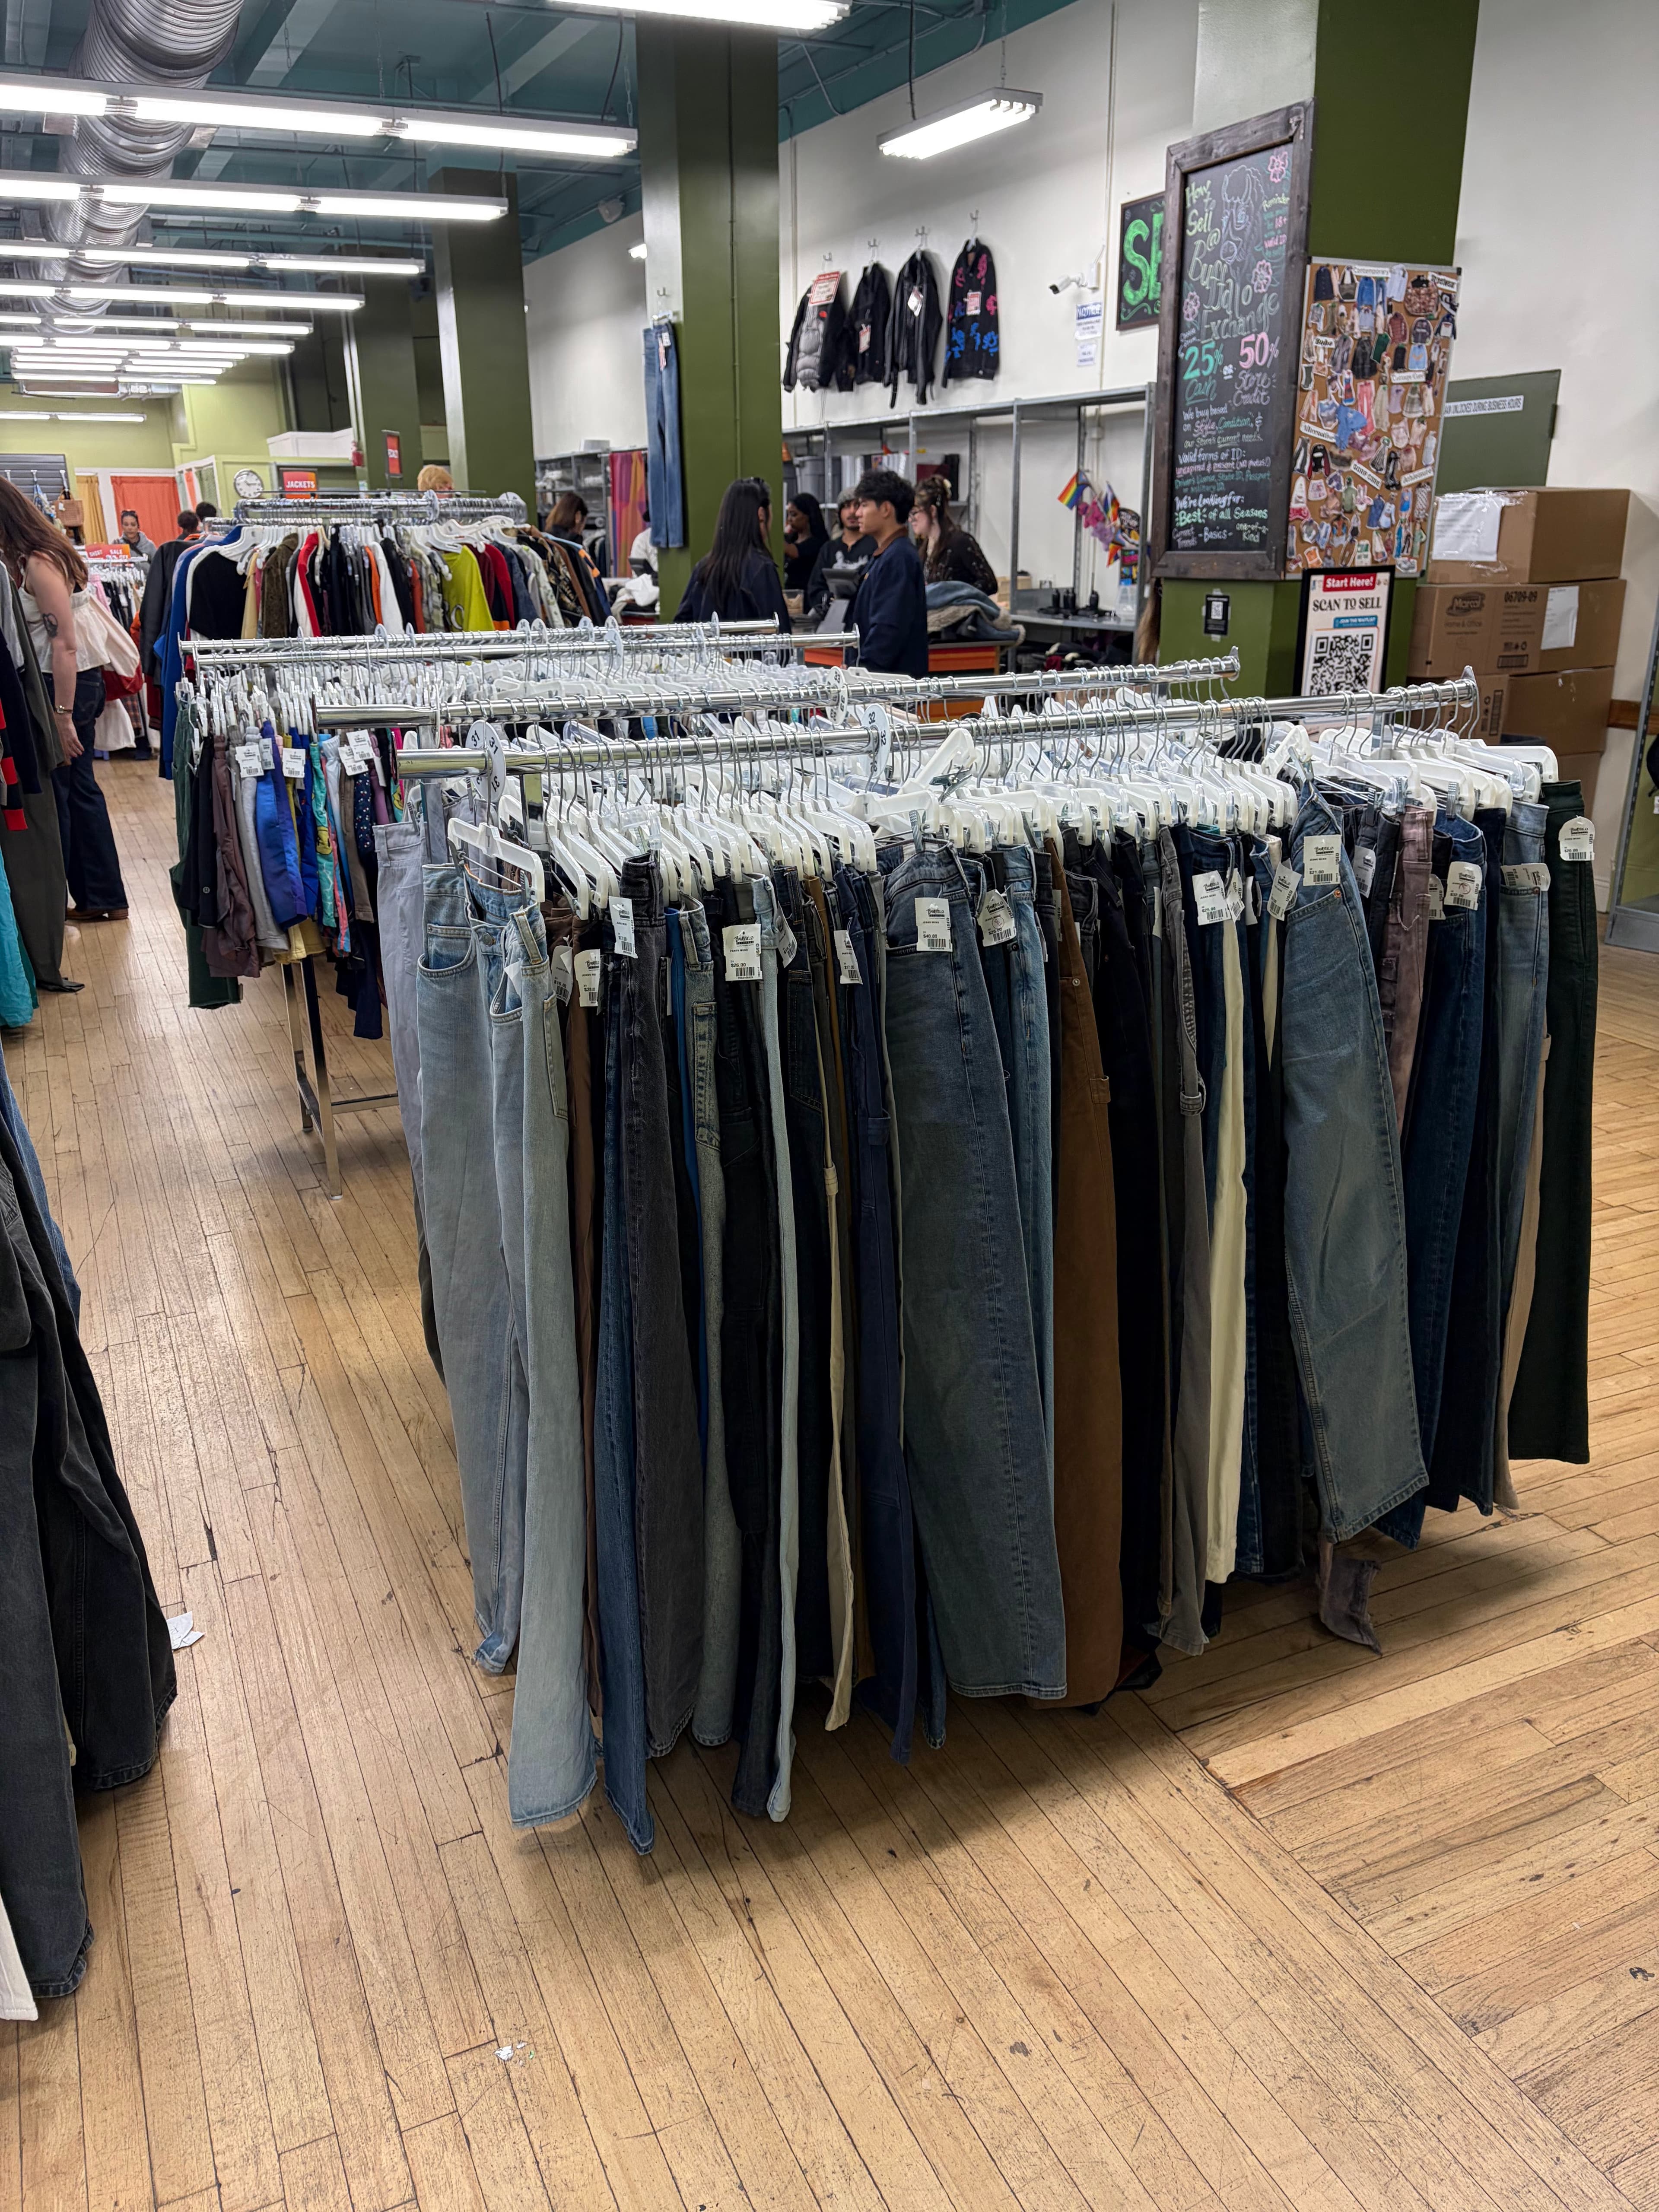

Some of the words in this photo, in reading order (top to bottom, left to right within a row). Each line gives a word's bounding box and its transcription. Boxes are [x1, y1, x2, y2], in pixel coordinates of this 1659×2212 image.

[1185, 180, 1211, 209] How
[1186, 209, 1213, 236] Sell
[1200, 292, 1280, 343] Exchange
[1183, 341, 1224, 380] 25%
[1239, 332, 1280, 369] 50%
[1235, 370, 1271, 391] Store
[1233, 387, 1271, 407] Credit
[286, 480, 315, 489] JACKETS
[1178, 508, 1203, 527] Best
[1208, 508, 1218, 521] of
[1219, 508, 1231, 520] all
[1233, 507, 1268, 519] Seasons
[1325, 577, 1348, 588] Start
[1350, 575, 1374, 588] Here!
[1313, 598, 1341, 612] SCAN
[1343, 597, 1356, 610] TO
[1359, 596, 1382, 610] SELL
[868, 711, 875, 725] 32
[471, 730, 480, 747] 31
[489, 737, 498, 755] 31
[880, 729, 886, 746] 32
[491, 775, 500, 793] 31
